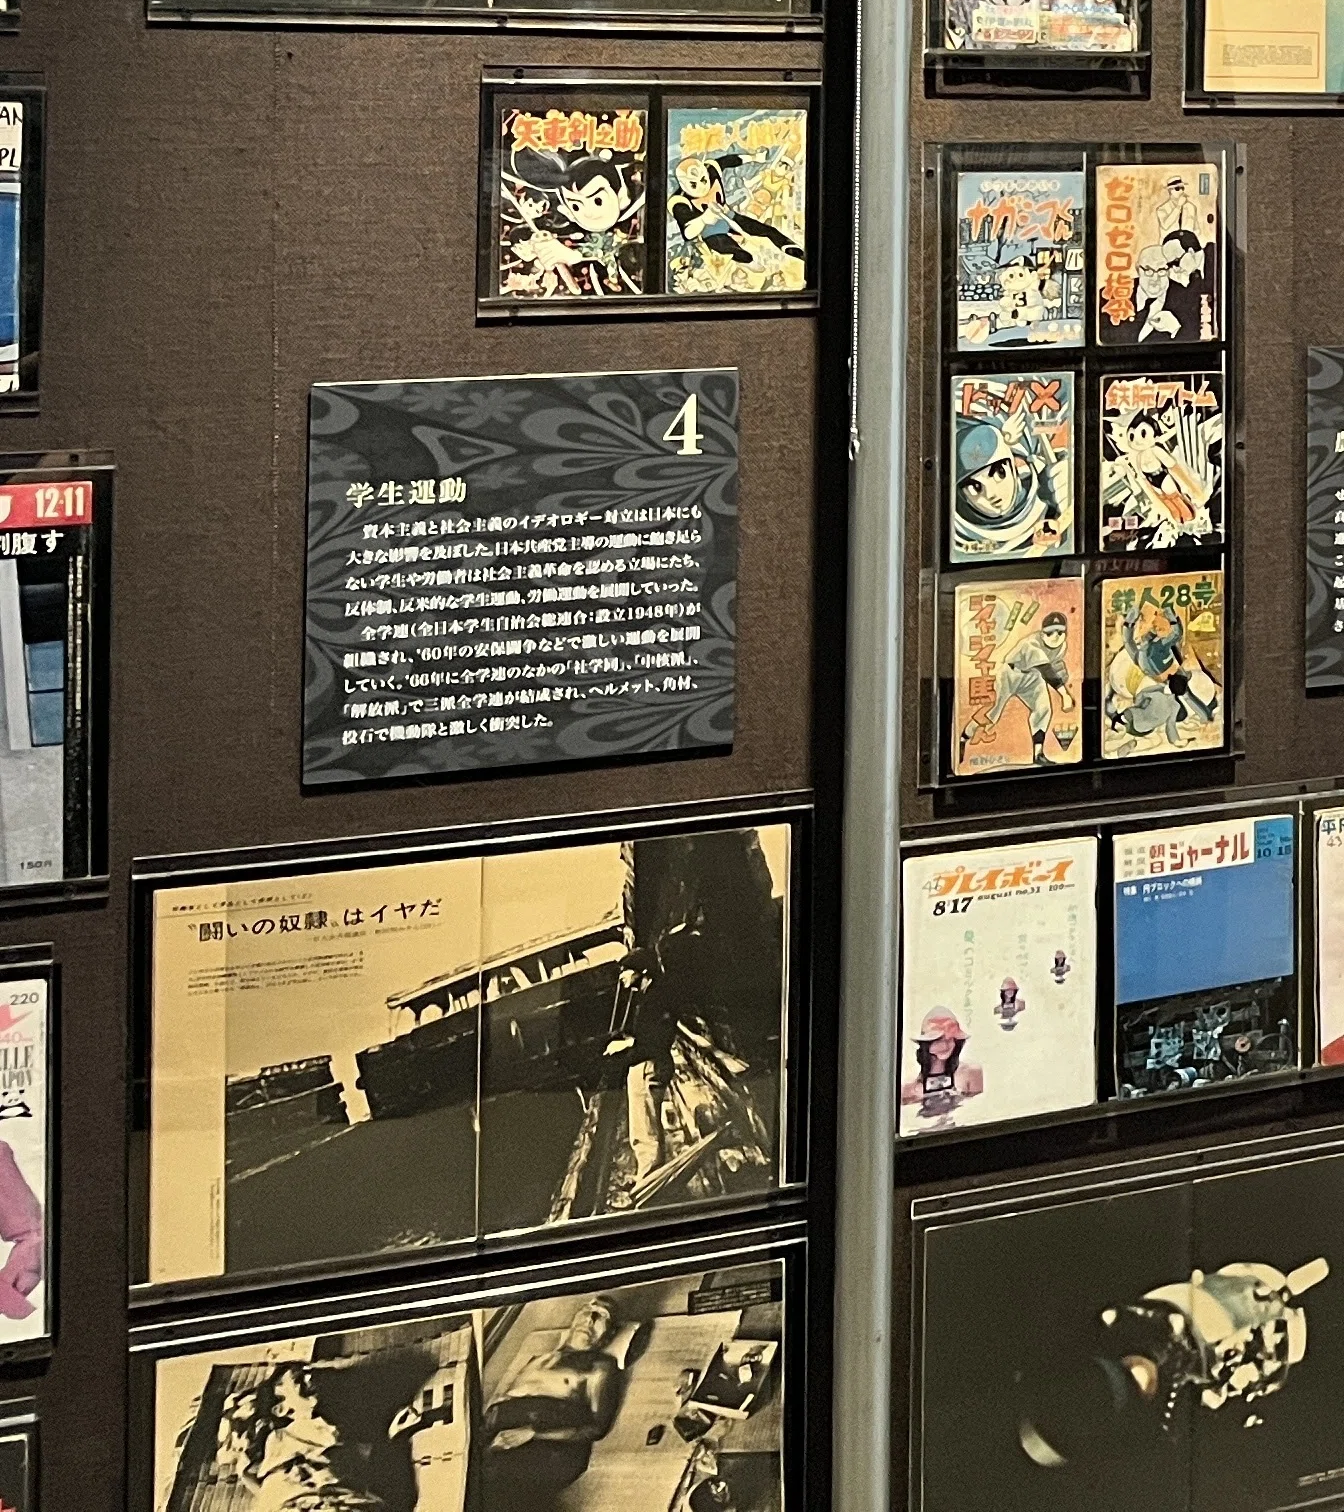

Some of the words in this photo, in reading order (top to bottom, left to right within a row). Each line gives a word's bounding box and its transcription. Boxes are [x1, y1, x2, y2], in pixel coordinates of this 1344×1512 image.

[511, 113, 643, 152] 矢車剣之助
[1104, 376, 1219, 409] 鉄腕アトム
[663, 393, 704, 454] 4
[346, 477, 467, 508] 学生運動
[1109, 582, 1217, 614] 鉄人28号
[1149, 831, 1251, 875] 朝日ジャーナル
[928, 859, 1075, 899] プレイボーイ
[9, 991, 40, 1007] 220
